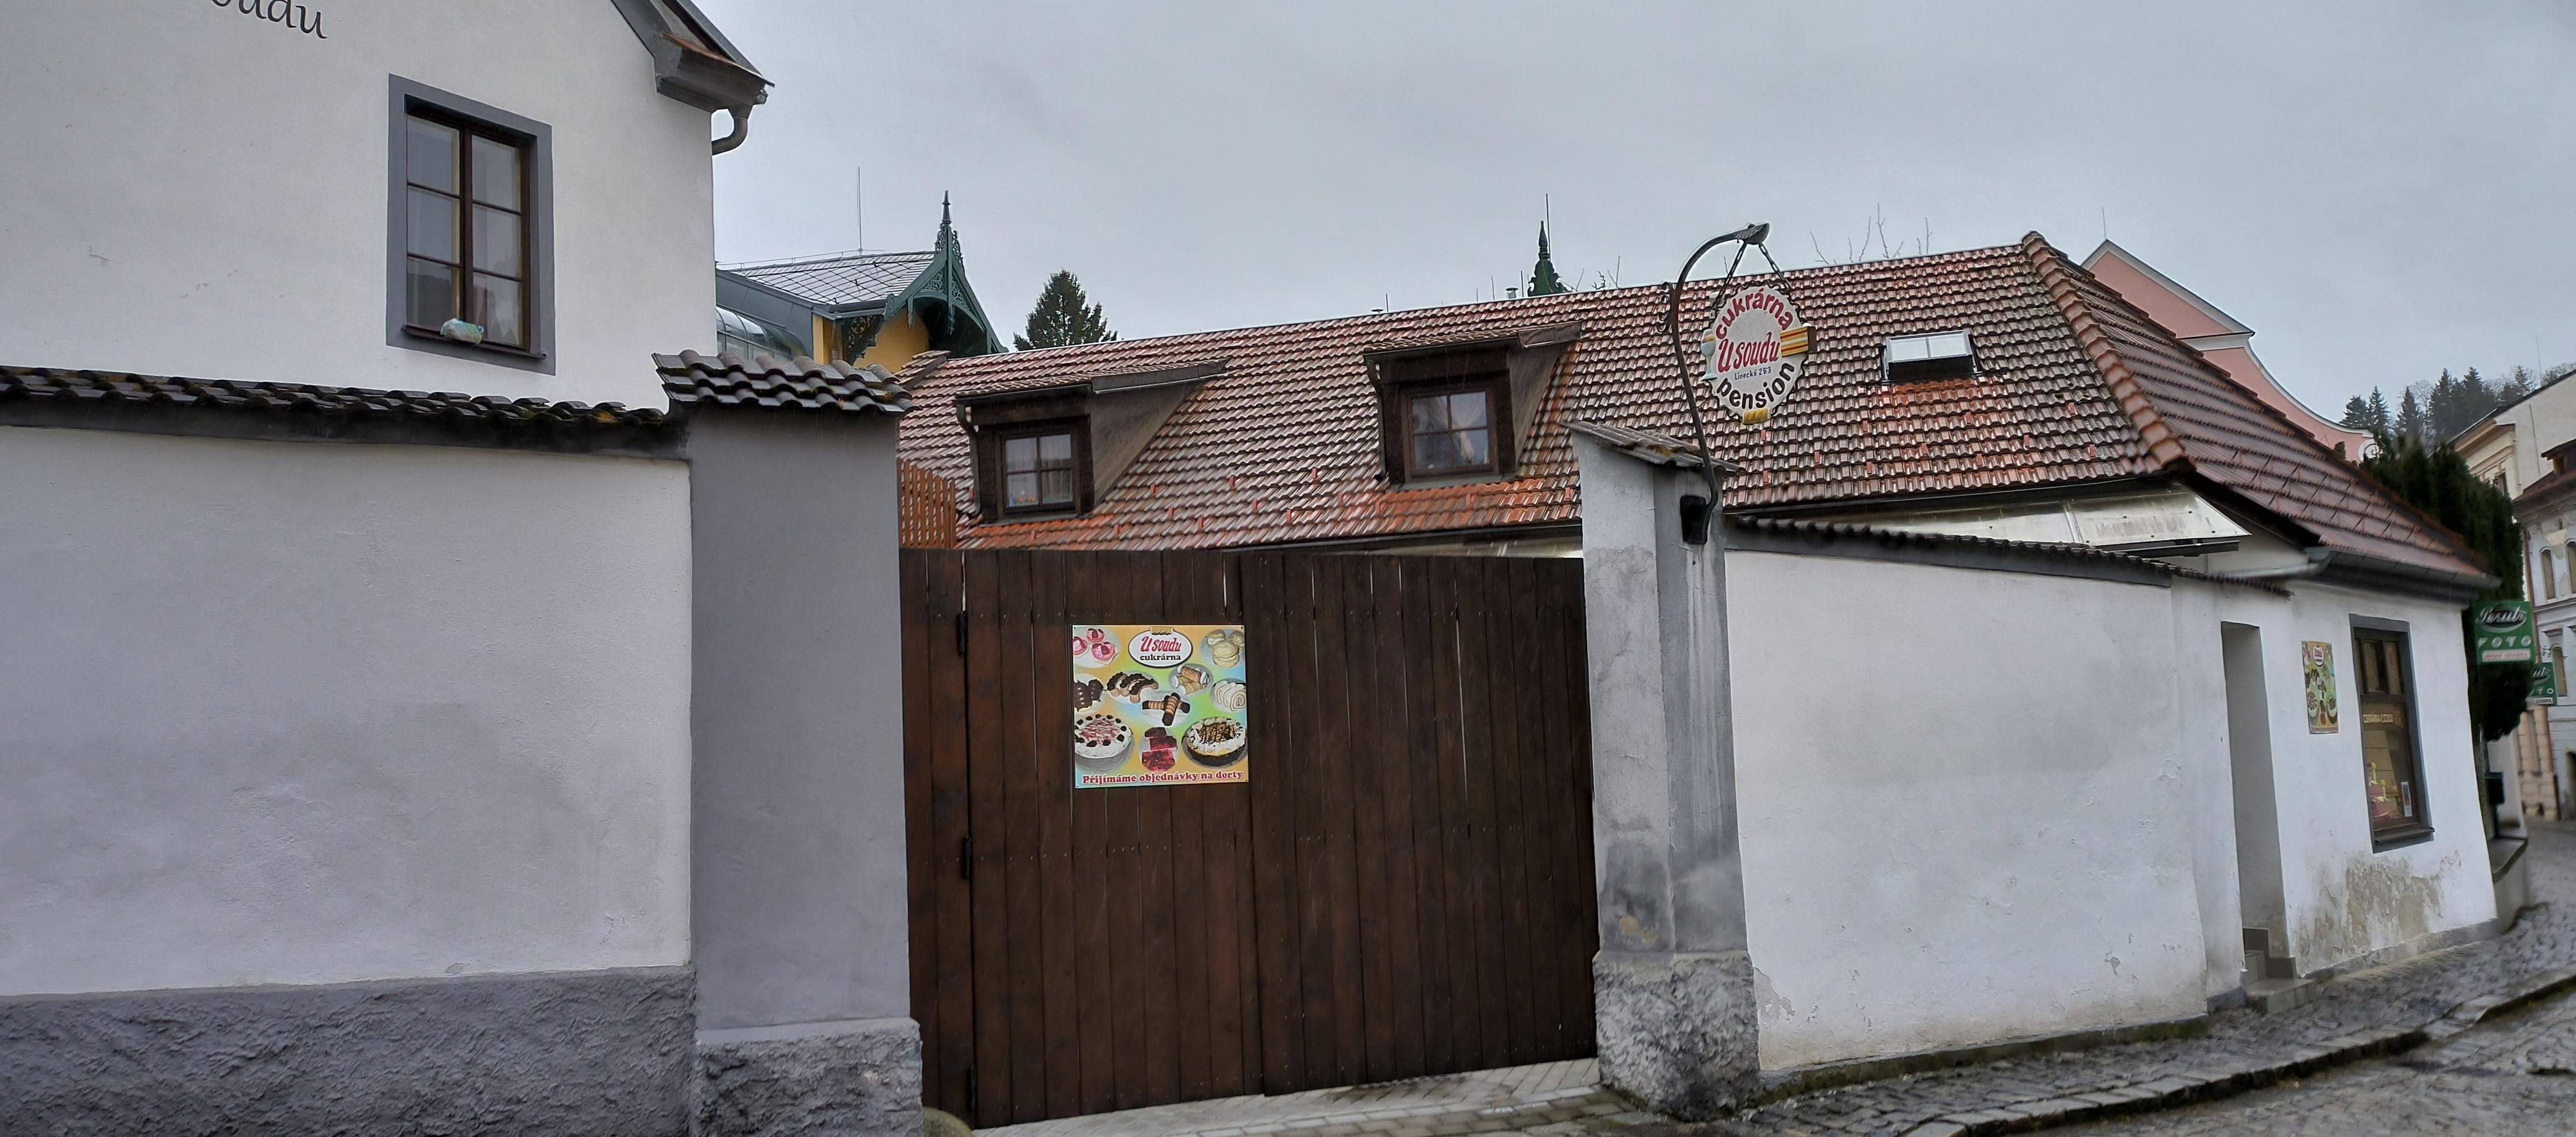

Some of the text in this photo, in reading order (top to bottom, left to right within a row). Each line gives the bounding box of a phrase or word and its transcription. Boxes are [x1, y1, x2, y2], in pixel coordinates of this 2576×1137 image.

[1716, 287, 1794, 339] cukrárna
[1718, 332, 1780, 373] U soudu
[1716, 363, 1795, 410] pension
[1140, 636, 1182, 652] U soudu
[2477, 635, 2532, 649] FOTO
[1139, 772, 1198, 783] objednávky
[1215, 771, 1243, 779] dorty
